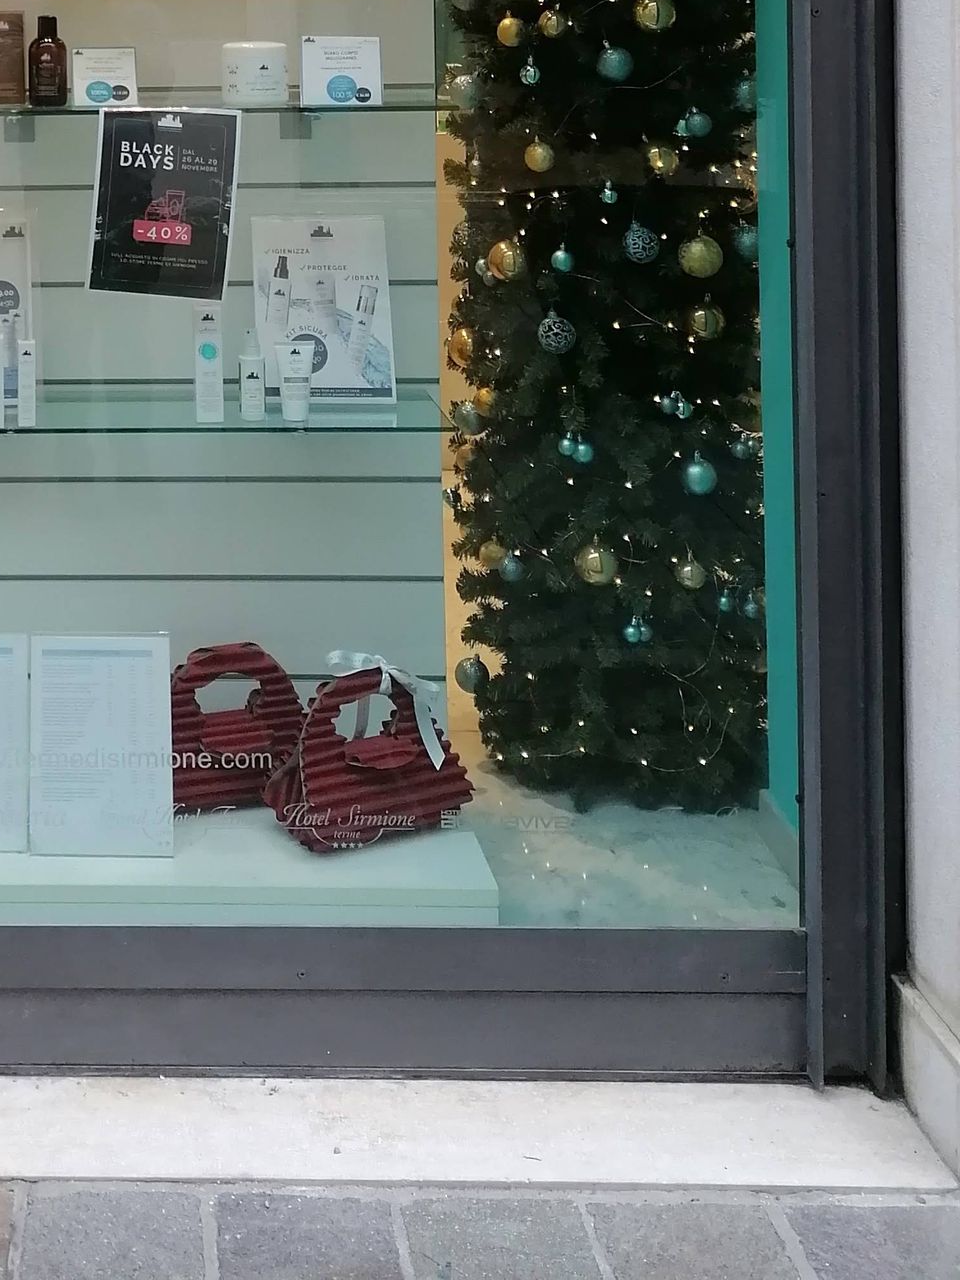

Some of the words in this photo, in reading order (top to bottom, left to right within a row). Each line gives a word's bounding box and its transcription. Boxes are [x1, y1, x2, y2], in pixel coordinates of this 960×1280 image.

[121, 141, 175, 156] BLACK
[119, 153, 175, 170] DAYS
[137, 225, 189, 241] -40%
[283, 803, 330, 826] Hotel
[337, 804, 416, 827] Sirmione
[333, 830, 361, 840] terme
